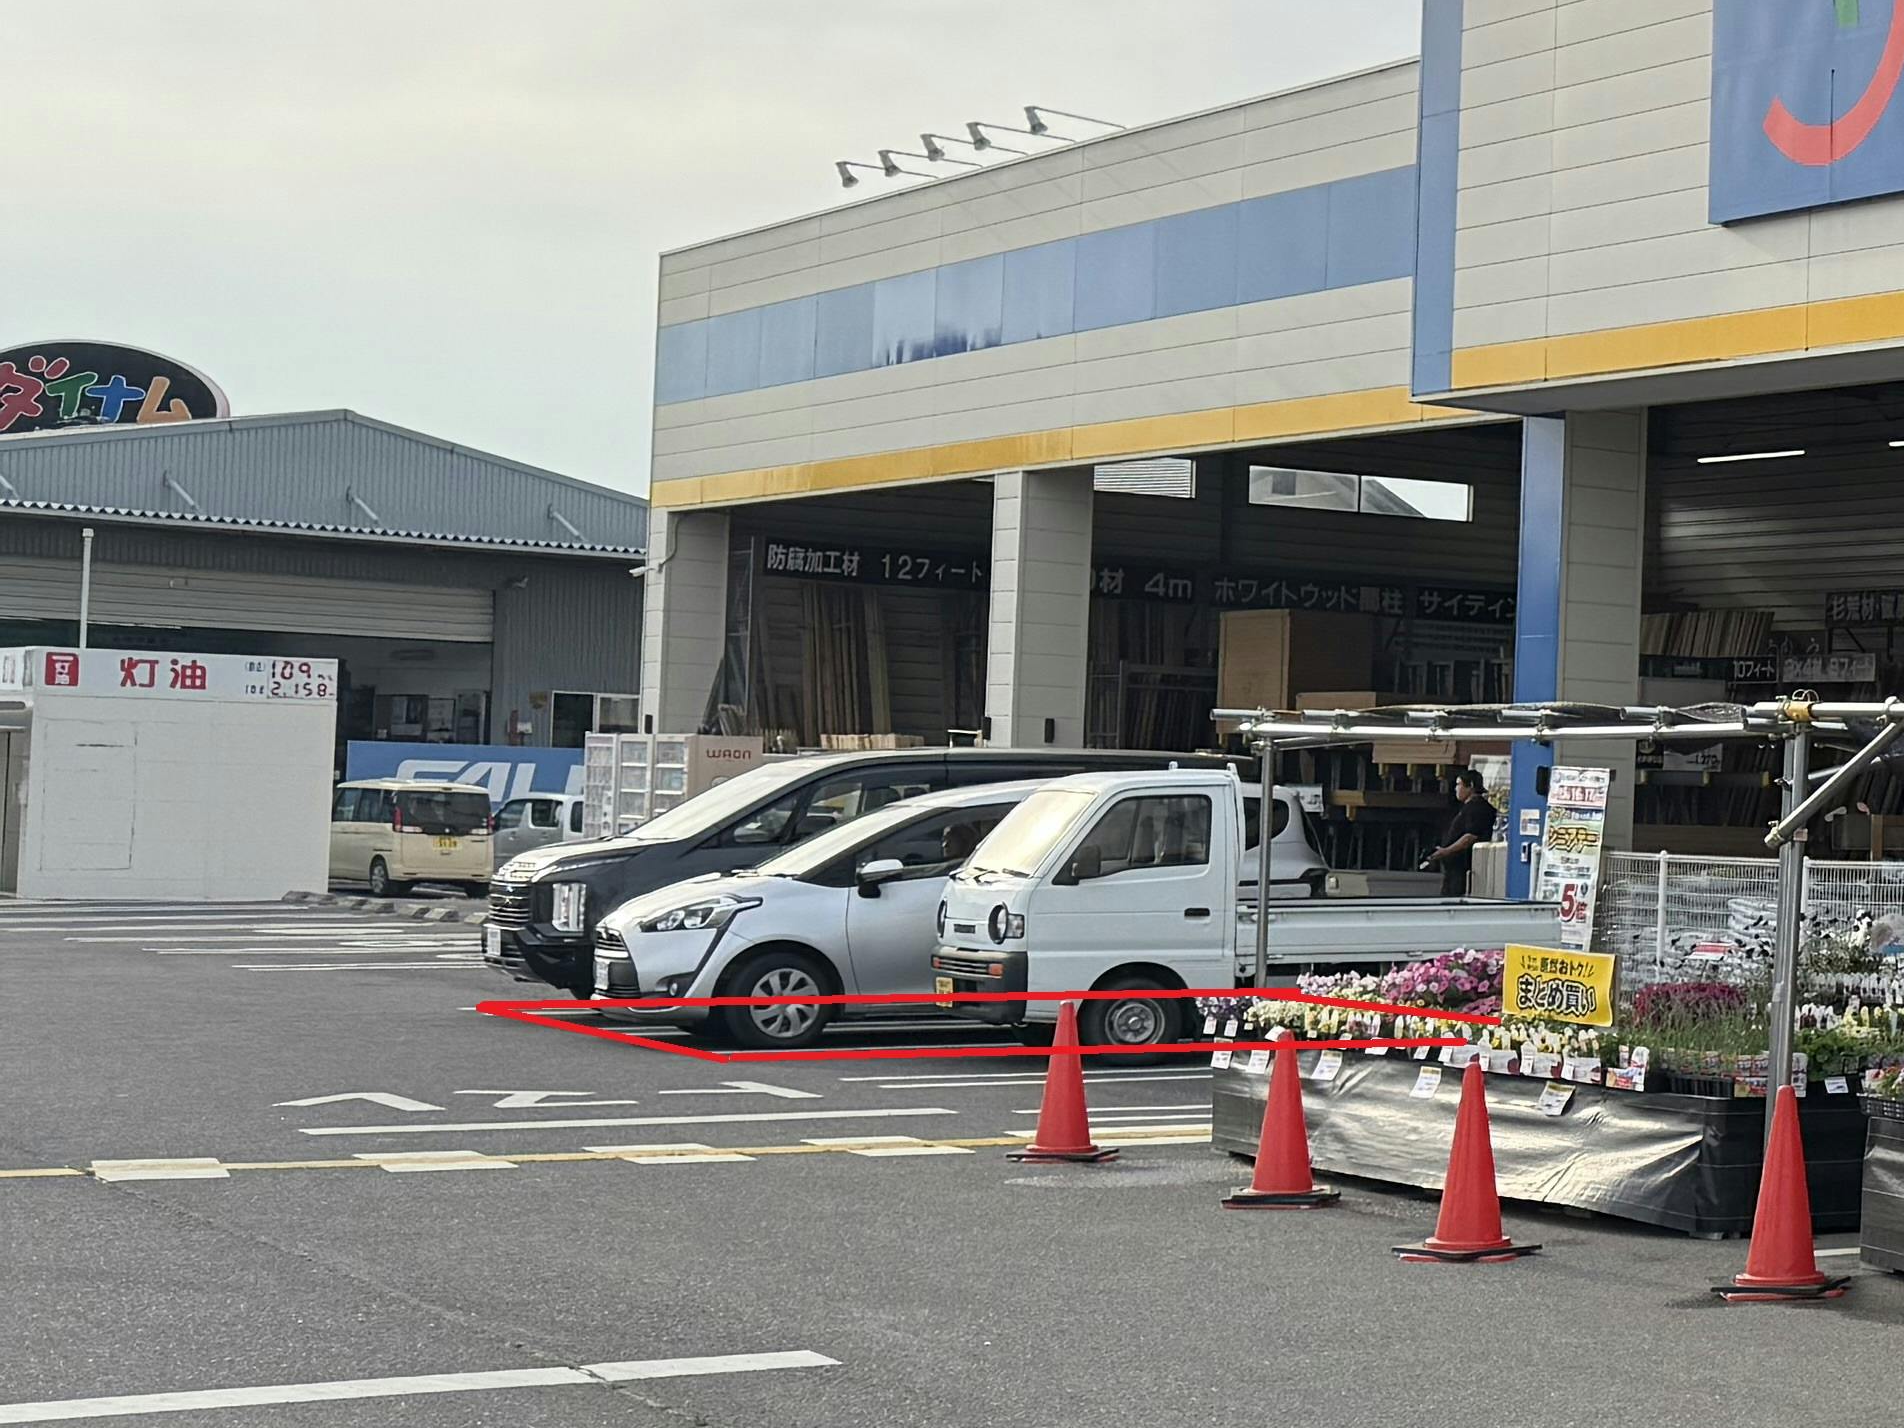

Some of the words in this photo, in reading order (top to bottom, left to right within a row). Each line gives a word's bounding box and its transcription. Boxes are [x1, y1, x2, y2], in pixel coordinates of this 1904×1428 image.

[767, 544, 860, 577] 防腐加工材
[120, 657, 207, 690] 灯油
[1517, 973, 1597, 1017] まとめ買い
